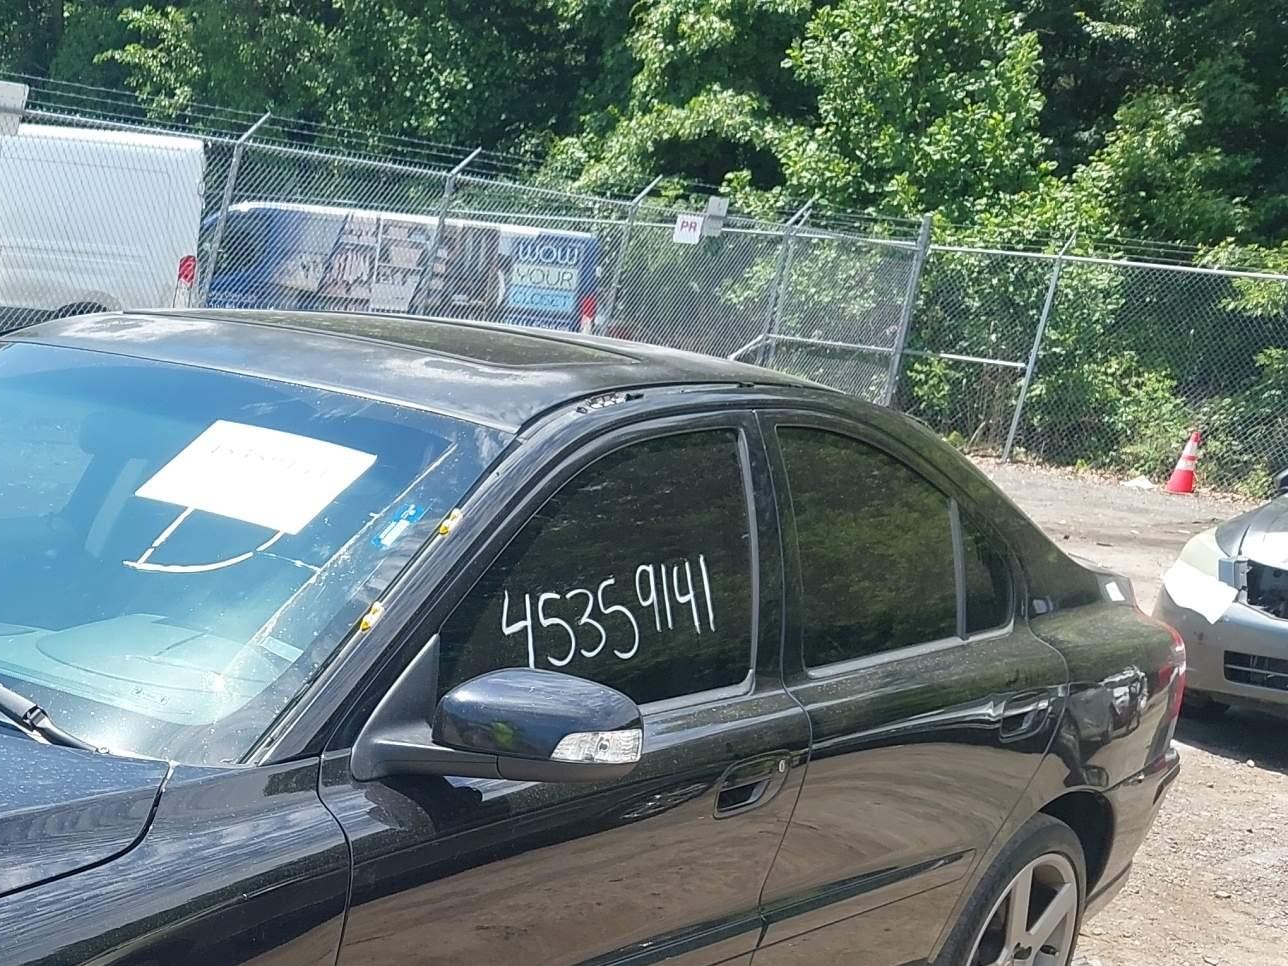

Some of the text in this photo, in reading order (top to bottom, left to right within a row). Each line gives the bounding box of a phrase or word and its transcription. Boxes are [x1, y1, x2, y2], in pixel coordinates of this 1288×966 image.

[680, 220, 698, 233] PR
[518, 242, 579, 266] WOW
[515, 266, 574, 288] YOUR
[501, 554, 716, 669] 45359141
